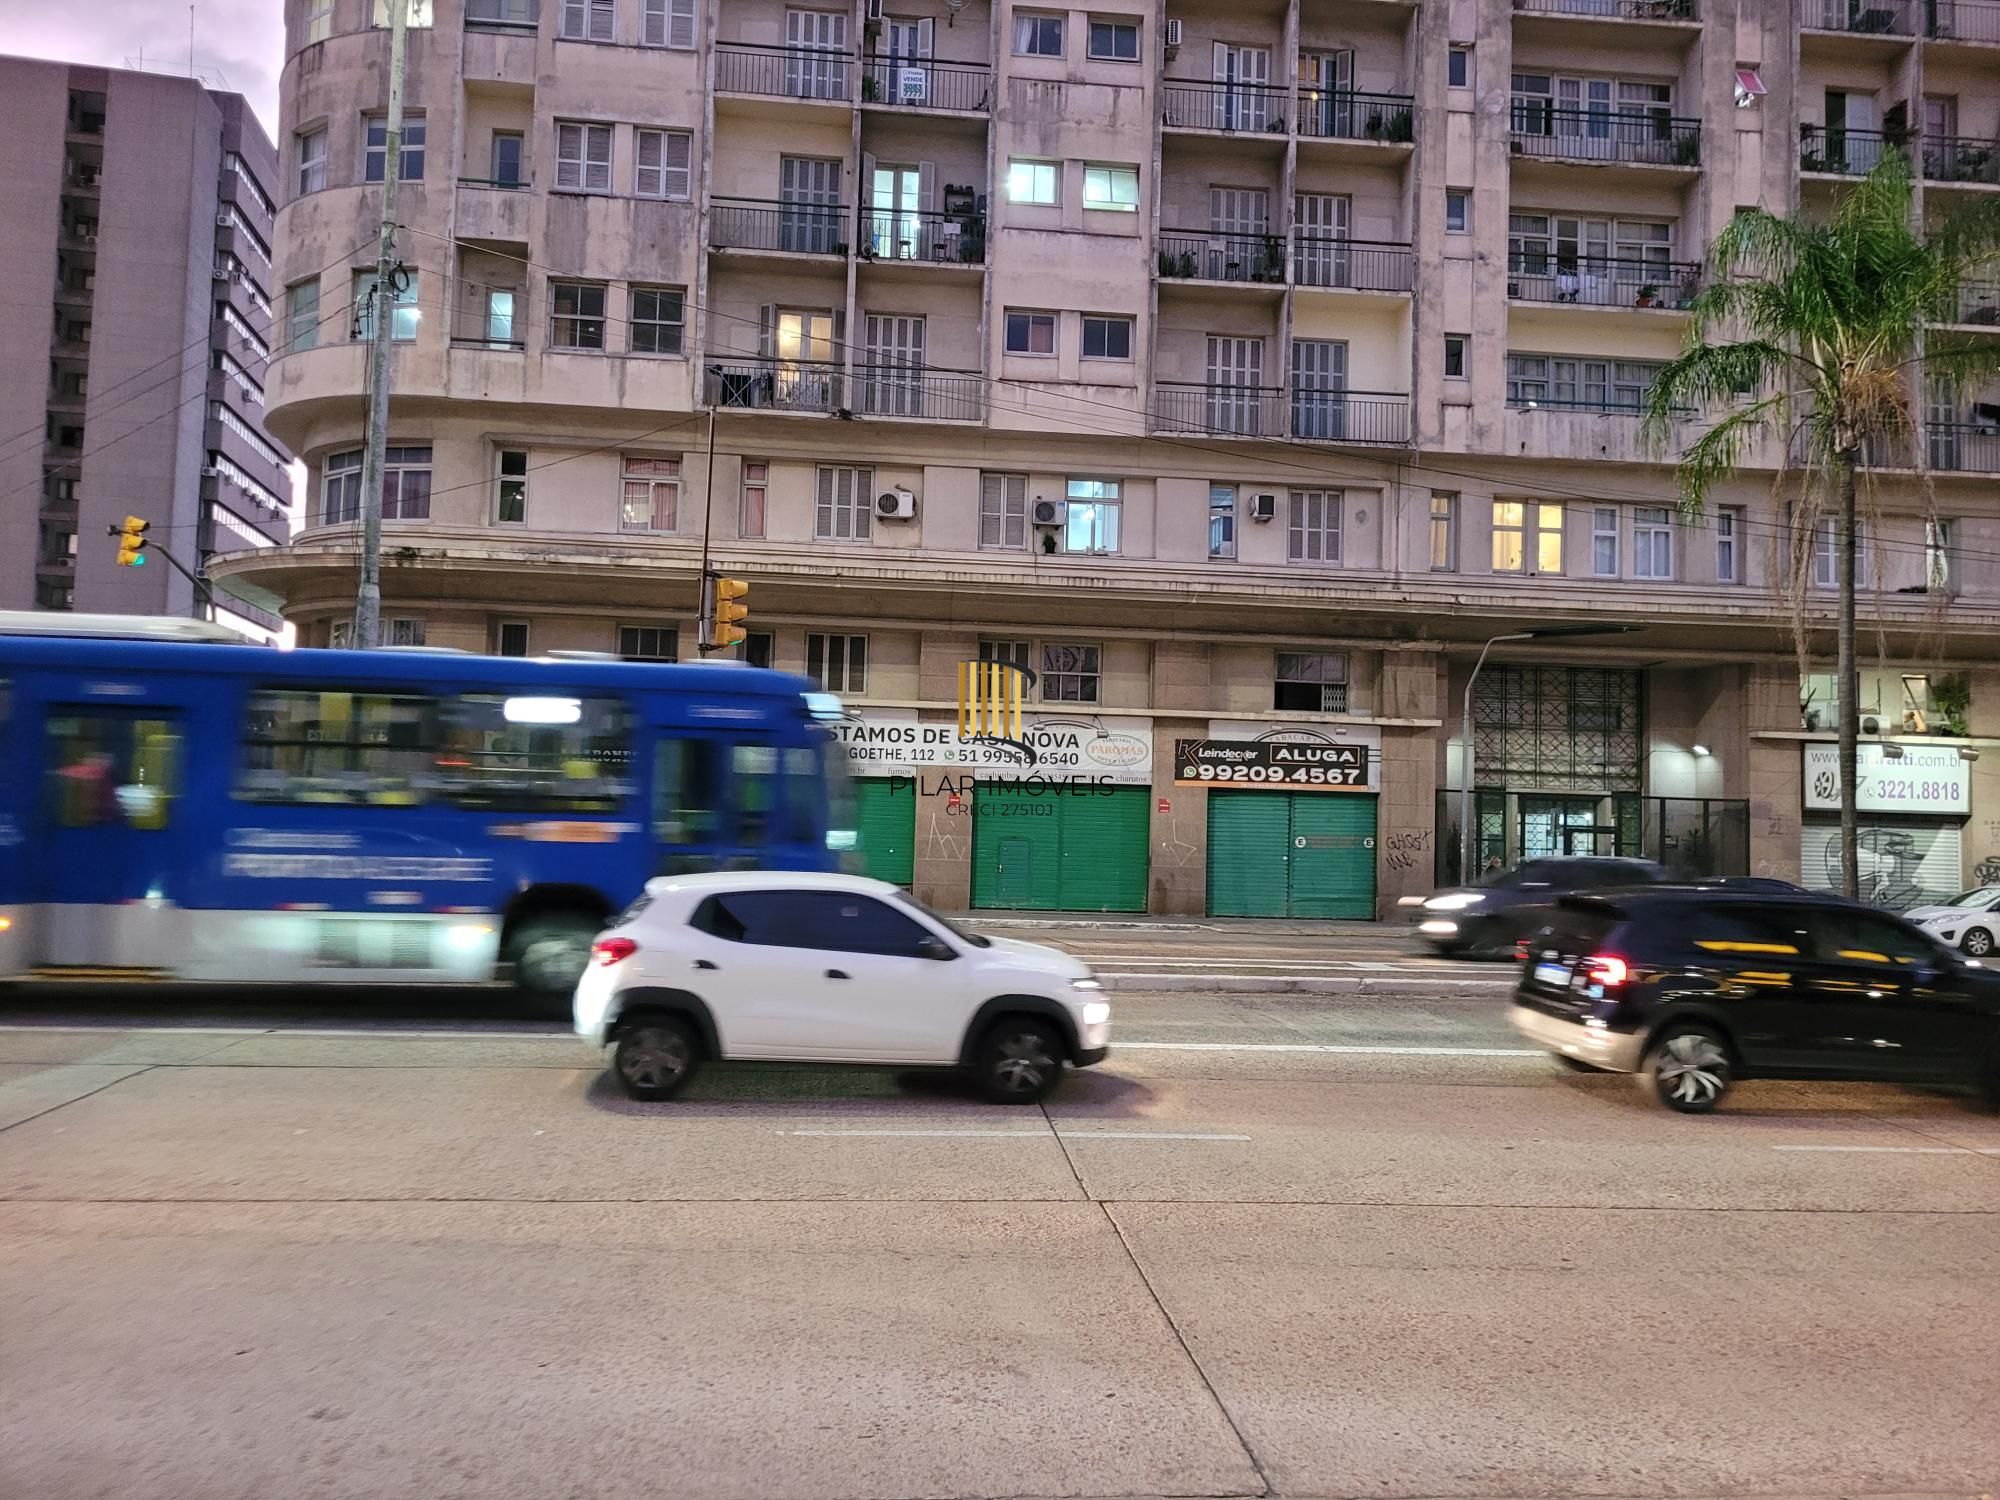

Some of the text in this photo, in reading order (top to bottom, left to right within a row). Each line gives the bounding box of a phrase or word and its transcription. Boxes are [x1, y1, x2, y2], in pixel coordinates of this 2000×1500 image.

[923, 729, 950, 744] DE
[1022, 732, 1079, 748] NOVA
[849, 747, 906, 761] GOETHE,
[911, 749, 934, 760] 112
[959, 750, 977, 761] 51
[1276, 749, 1355, 762] ALUGA
[1199, 764, 1360, 784] 99209.4567
[1878, 780, 1960, 800] 3221.8818
